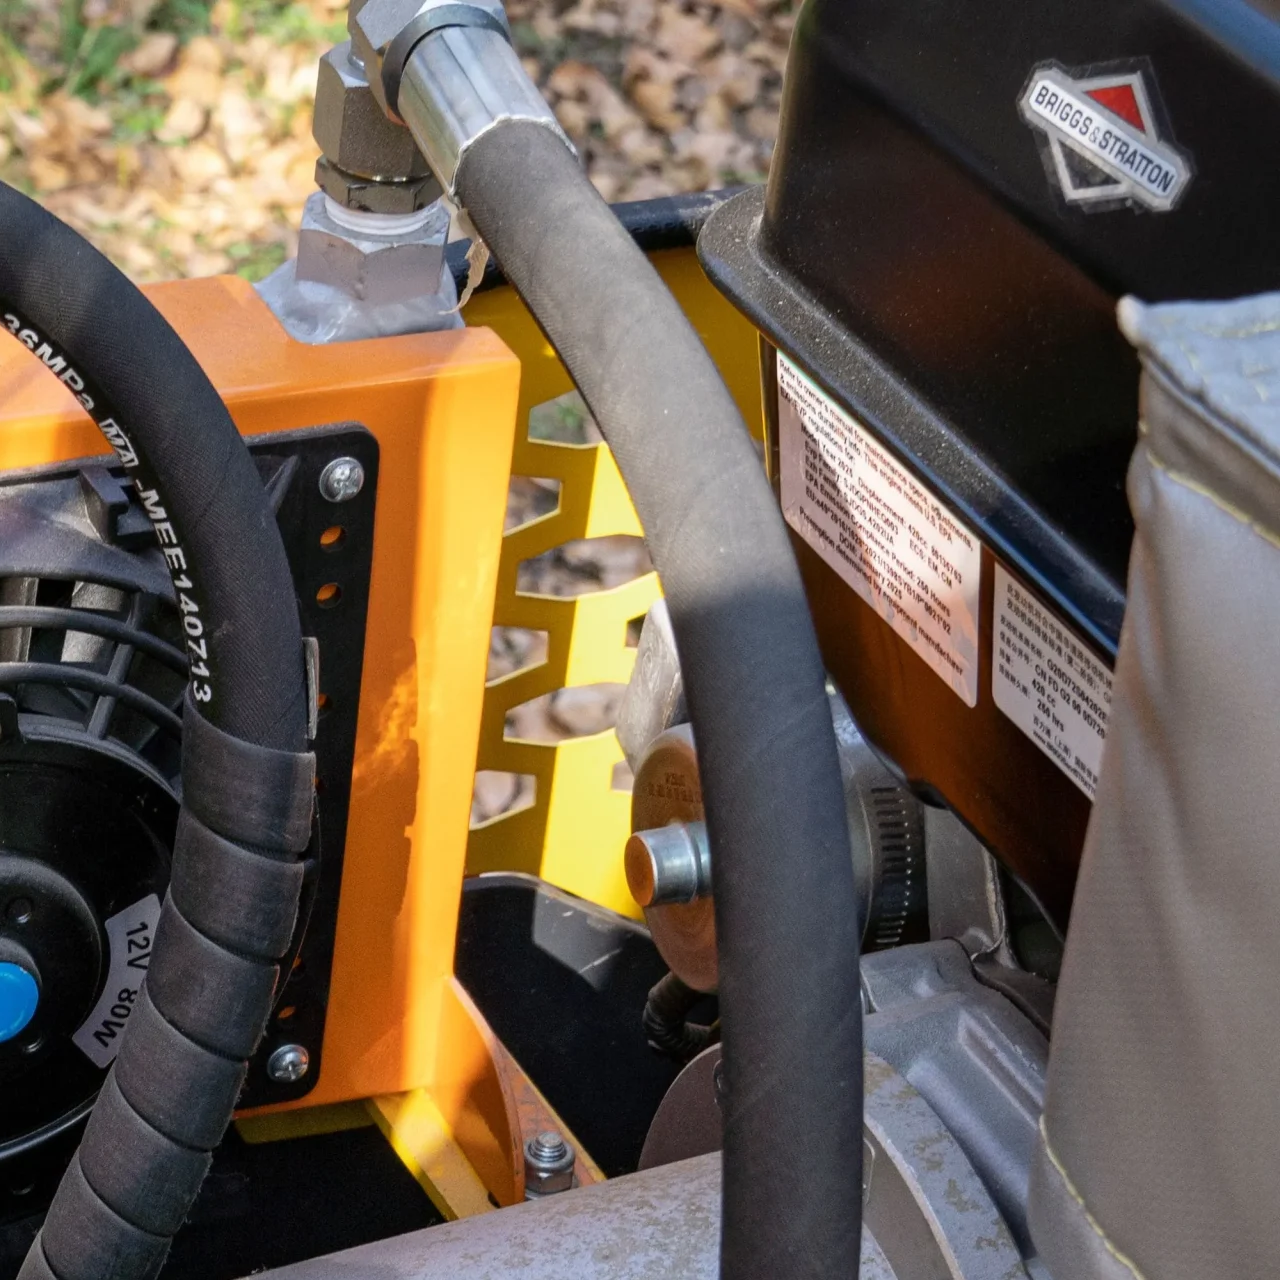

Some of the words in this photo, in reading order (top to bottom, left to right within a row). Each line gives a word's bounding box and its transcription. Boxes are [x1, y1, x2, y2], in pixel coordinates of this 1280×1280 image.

[1, 312, 94, 411] 36MPa
[786, 380, 815, 413] emissions
[817, 410, 846, 443] durability
[864, 452, 877, 470] This
[879, 468, 901, 495] engine
[903, 490, 923, 513] meets
[938, 523, 952, 542] EPA
[803, 383, 828, 411] owner's
[830, 407, 852, 433] manual
[854, 430, 863, 443] for
[865, 439, 907, 485] maintenance
[808, 414, 842, 454] regulations
[805, 470, 818, 488] EPA
[820, 484, 850, 518] Emission
[850, 514, 889, 557] Compliance
[930, 590, 950, 616] Hours
[858, 551, 884, 584] January
[835, 543, 871, 584] determined
[873, 579, 881, 595] by
[883, 590, 917, 632] equipment
[918, 625, 963, 676] manufacturer
[1052, 713, 1064, 733] hrs
[126, 921, 151, 970] 12V
[92, 988, 138, 1049] 80W
